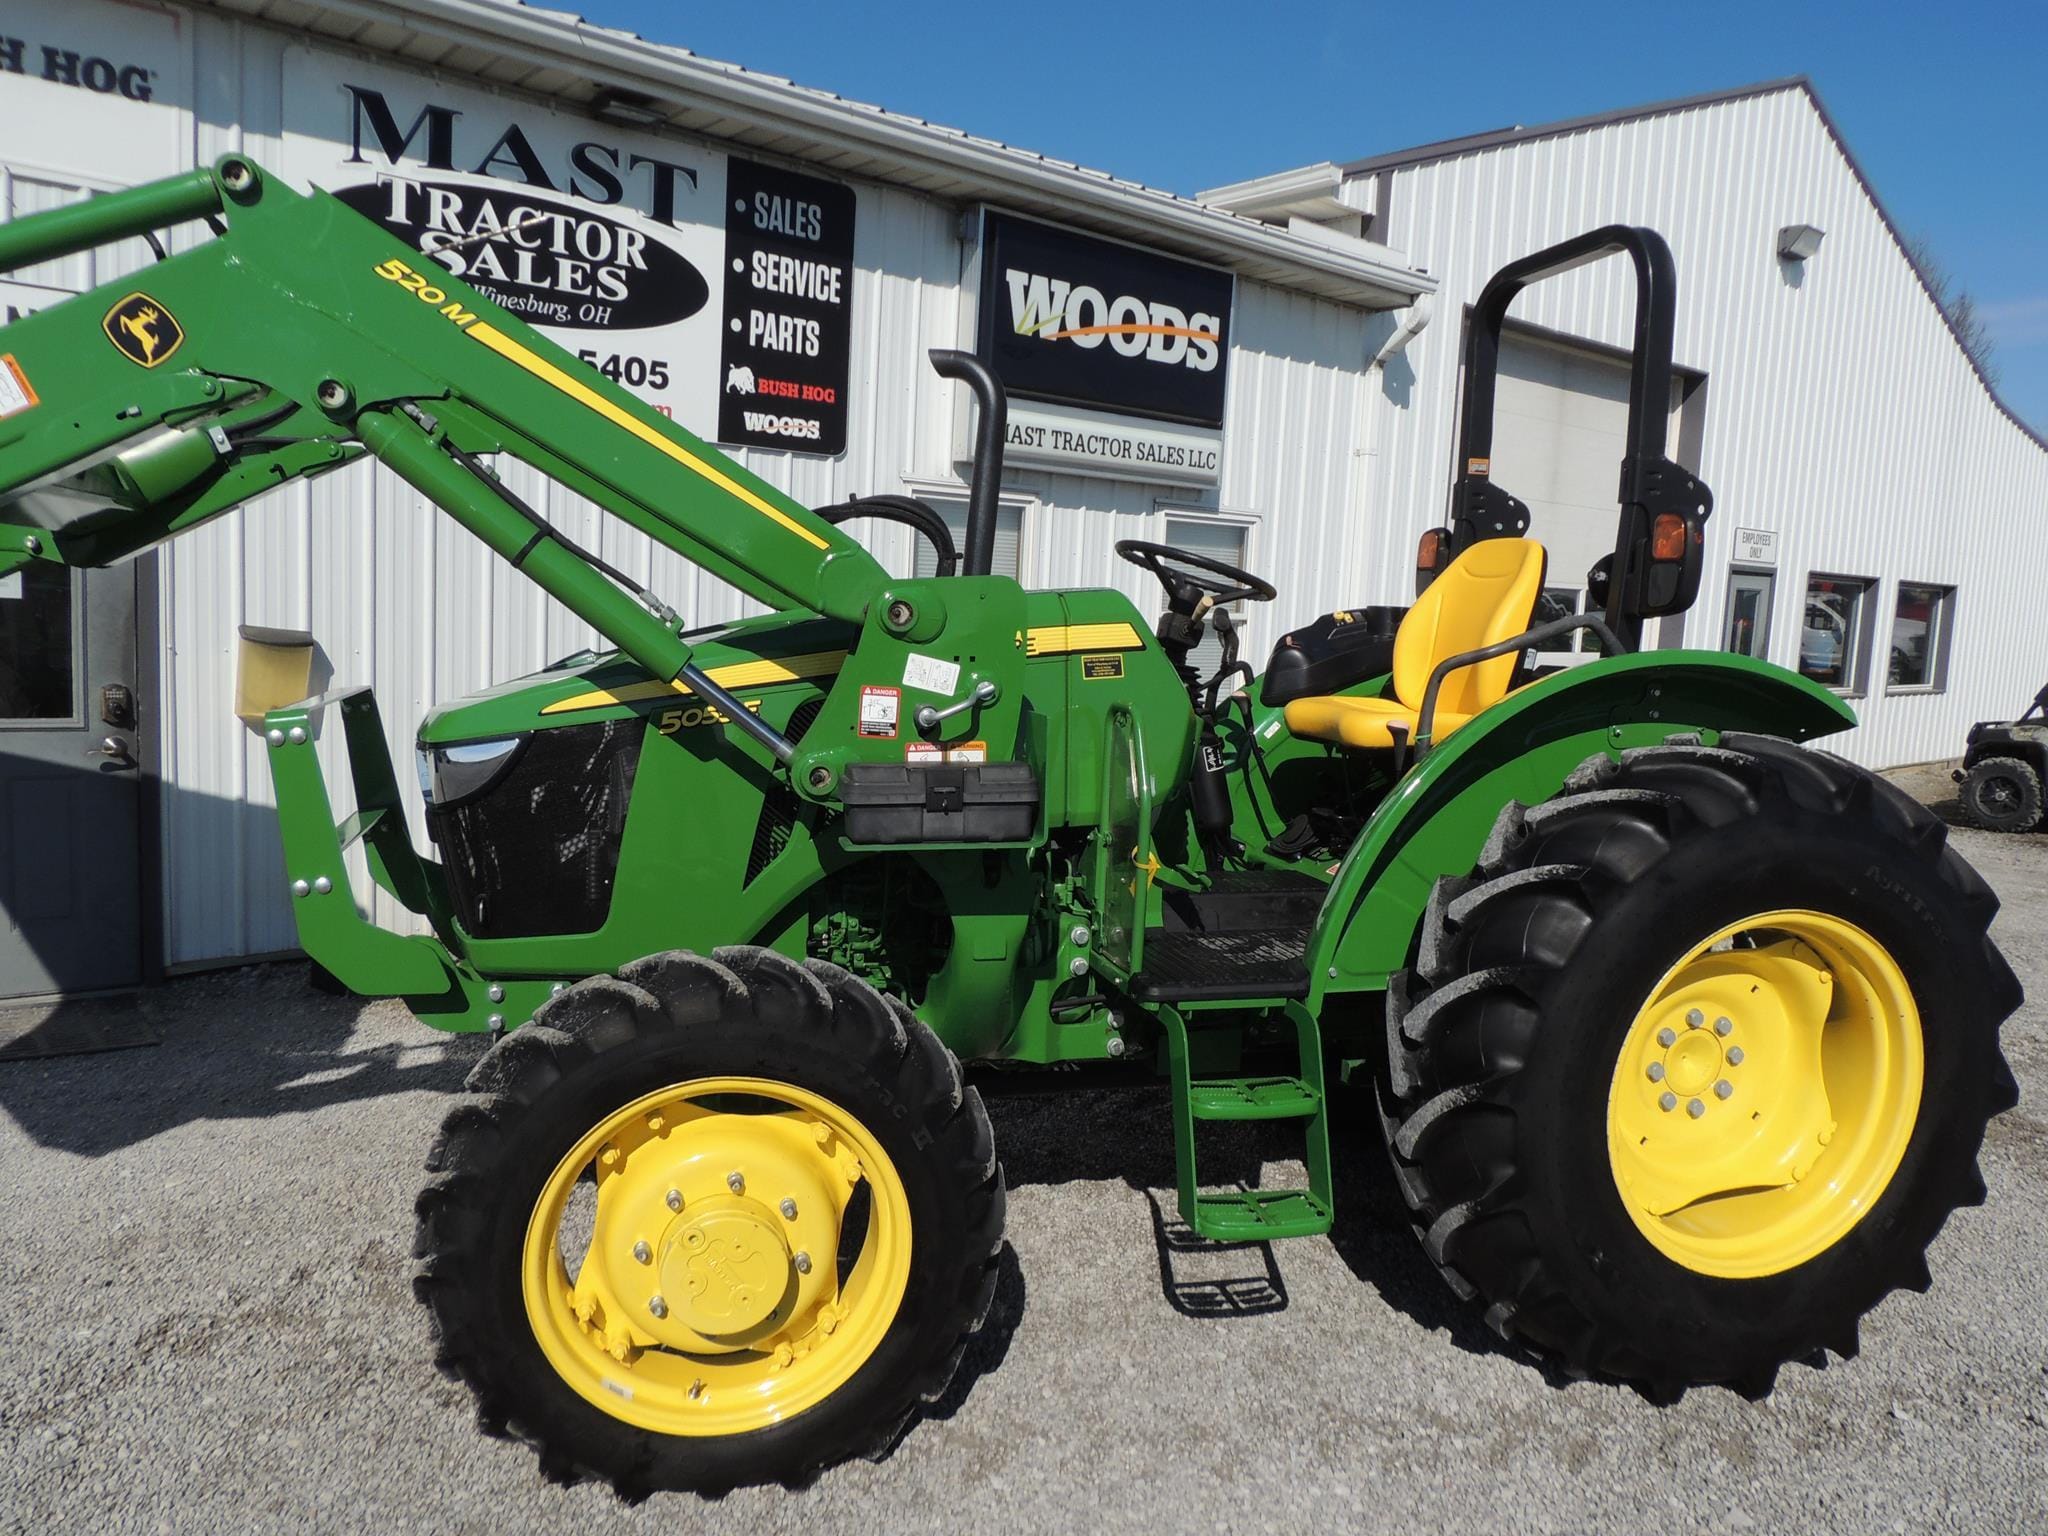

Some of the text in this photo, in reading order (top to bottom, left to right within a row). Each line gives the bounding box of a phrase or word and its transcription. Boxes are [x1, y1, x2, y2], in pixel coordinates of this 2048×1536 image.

[40, 45, 152, 103] HOG
[343, 83, 698, 232] MAST
[376, 171, 649, 271] TRACTOR
[754, 191, 822, 241] SALES
[418, 231, 630, 302] SALES
[751, 250, 842, 304] SERVICE
[373, 259, 478, 327] 520 M
[578, 303, 613, 325] OH
[749, 309, 821, 357] PARTS
[1006, 268, 1220, 372] WOODS
[758, 378, 836, 403] BUSH HOG
[743, 411, 821, 440] WOODS
[1051, 429, 1132, 460] TRACTOR
[1136, 441, 1185, 466] SALES
[1188, 450, 1217, 470] LLC
[1742, 531, 1771, 546] EMPLOYEES
[1749, 546, 1763, 558] ONLY
